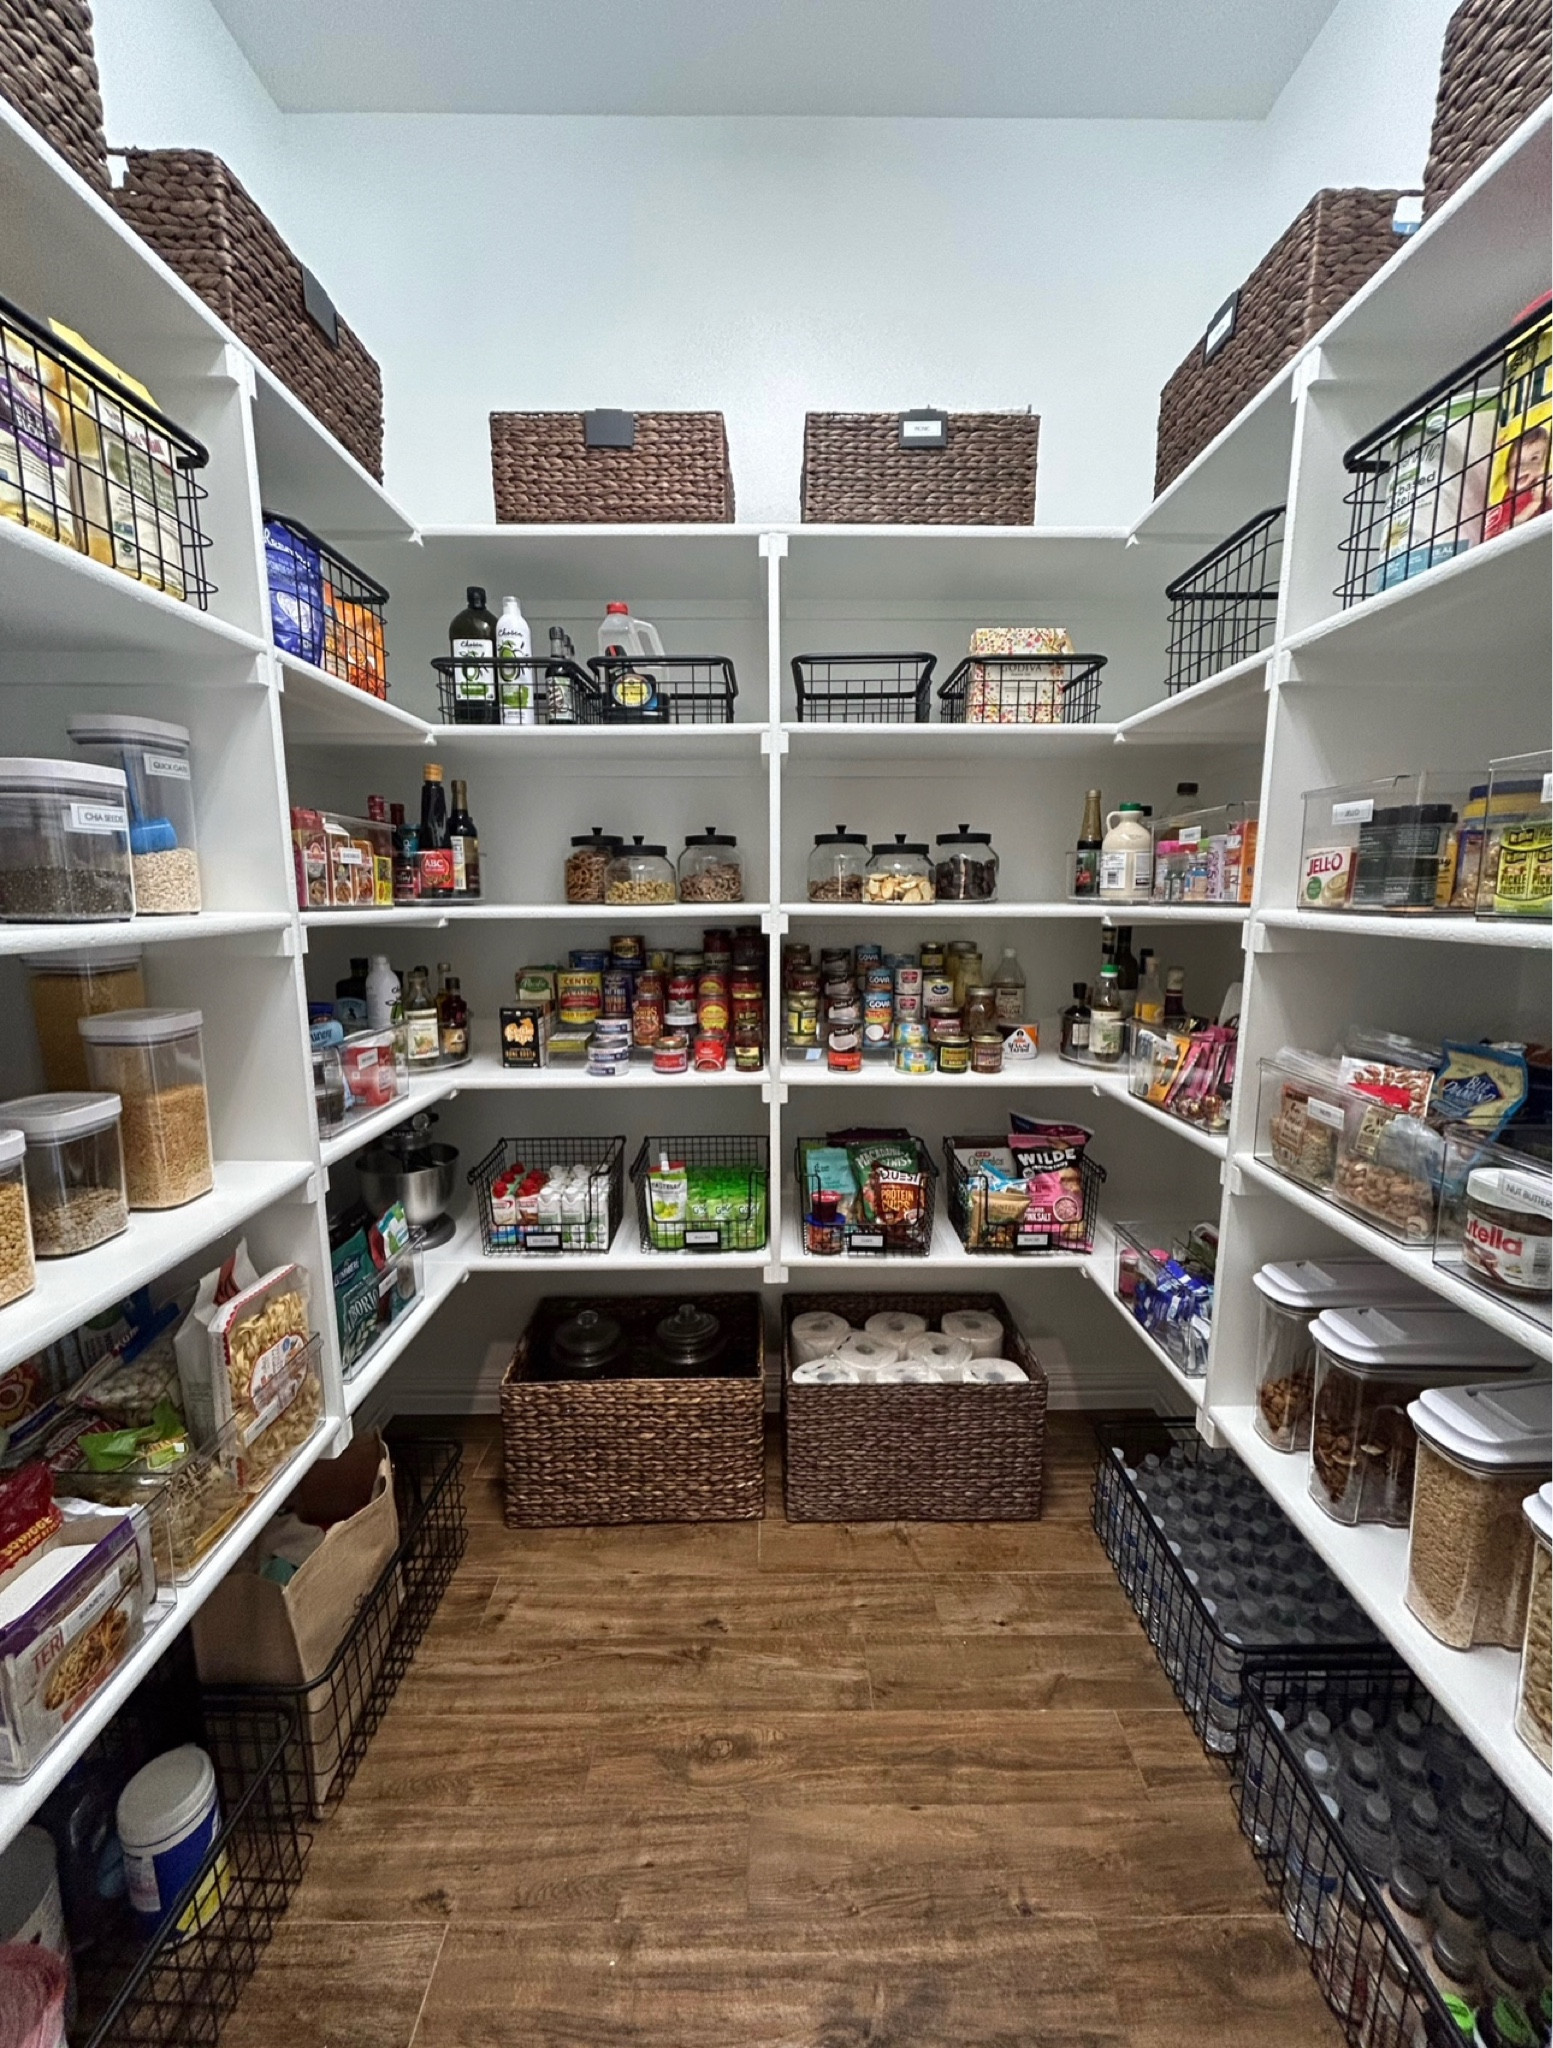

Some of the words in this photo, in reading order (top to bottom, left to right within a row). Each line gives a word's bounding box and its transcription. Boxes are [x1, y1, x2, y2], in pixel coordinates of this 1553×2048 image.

[84, 811, 104, 822] CHIA
[104, 813, 125, 824] SEEDS
[1306, 852, 1343, 877] JELL-O
[868, 1000, 891, 1009] GOYA
[1017, 1148, 1077, 1167] WILDE
[880, 1169, 918, 1182] QUEST
[881, 1190, 914, 1201] PROTEIN
[1506, 1184, 1522, 1196] NUT
